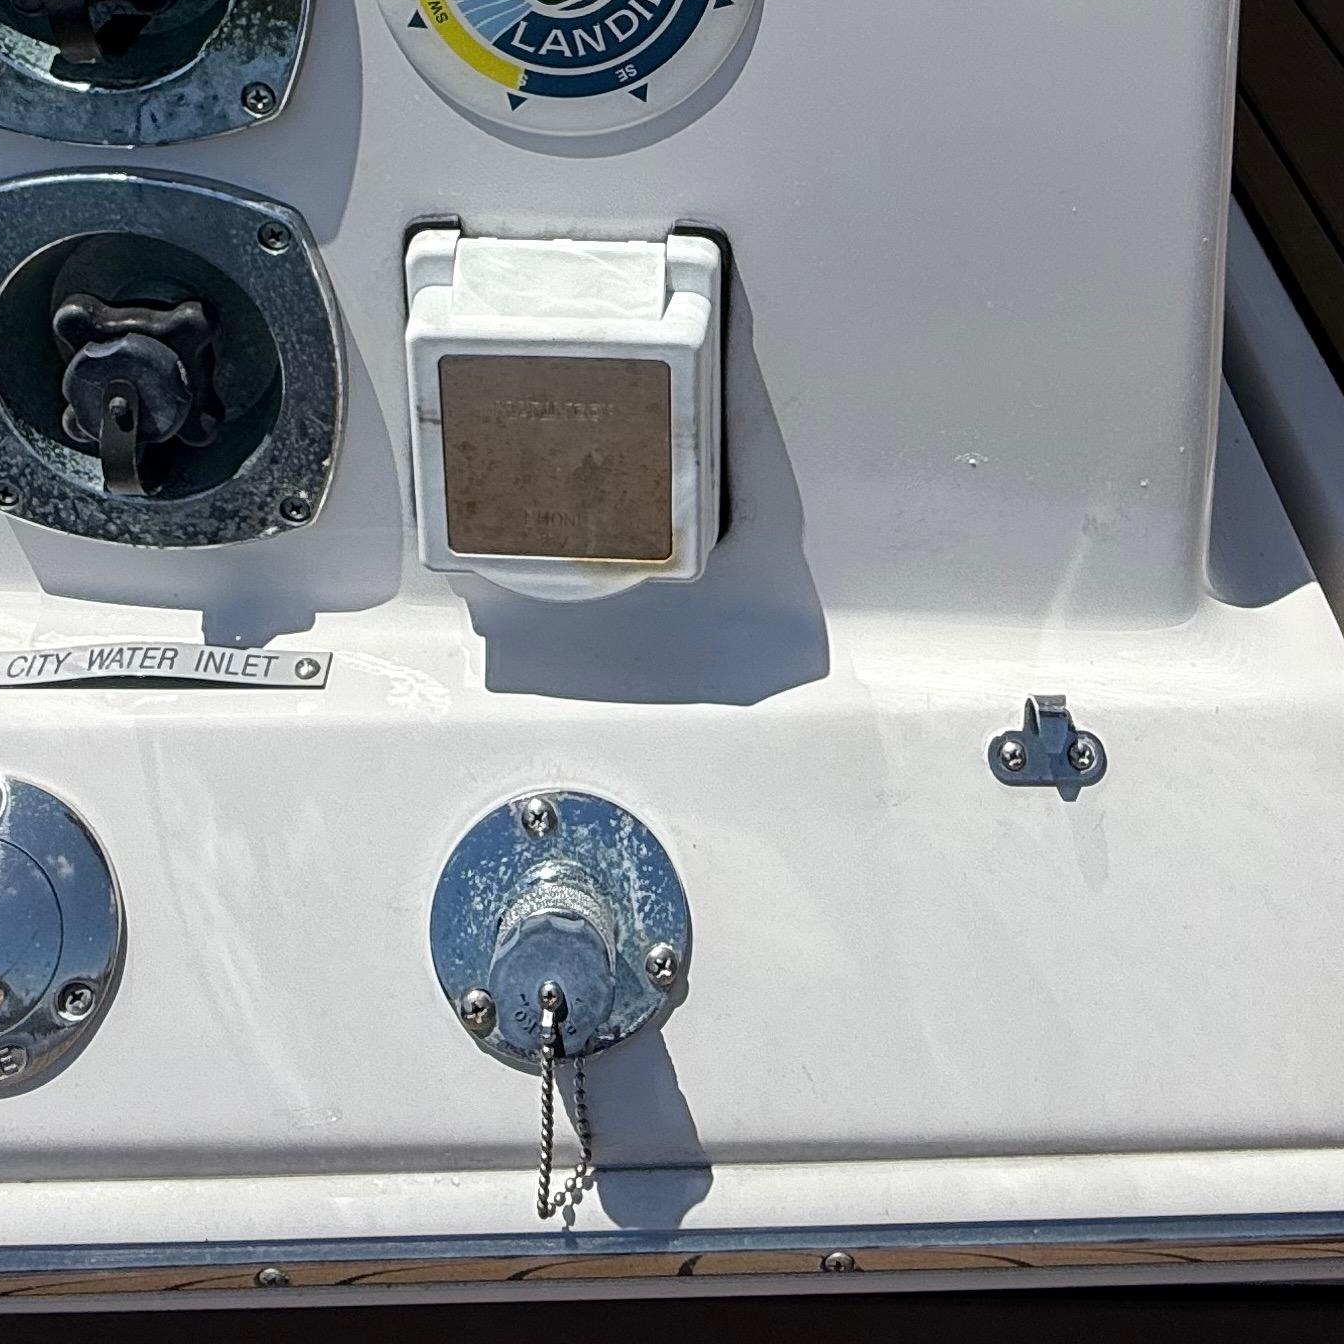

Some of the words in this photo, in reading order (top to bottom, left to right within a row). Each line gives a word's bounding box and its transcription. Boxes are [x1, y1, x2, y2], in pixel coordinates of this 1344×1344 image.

[428, 0, 449, 25] SW
[614, 64, 638, 82] SE
[6, 651, 71, 679] CITY
[86, 647, 177, 672] WATER
[194, 649, 280, 678] INLET
